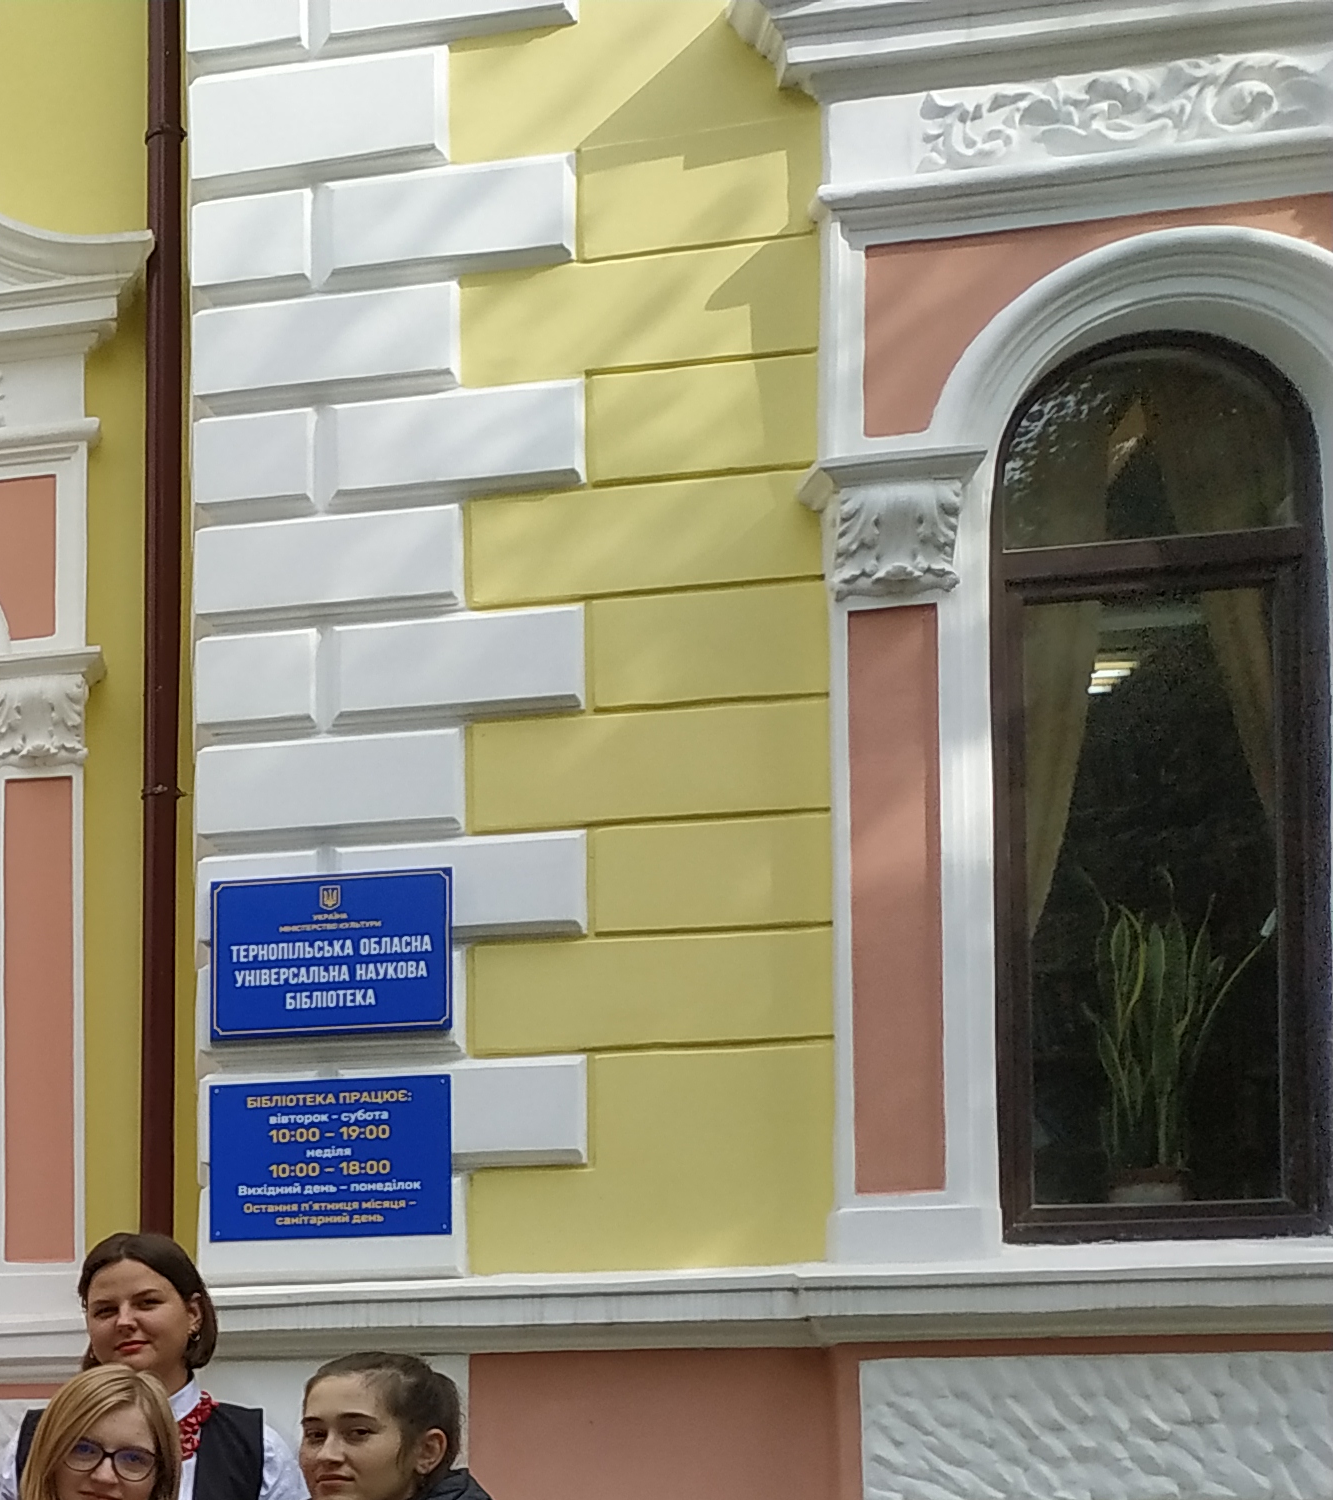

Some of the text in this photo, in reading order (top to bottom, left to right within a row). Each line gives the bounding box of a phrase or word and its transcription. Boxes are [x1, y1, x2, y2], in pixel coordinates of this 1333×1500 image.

[230, 934, 432, 963] ТЕРНОПІЛЬСЬКА ОБЛАСНА
[234, 961, 428, 988] УНІВЕРСАЛЬНА НАУКОВА
[285, 988, 376, 1010] БІБЛІОТЕКА
[246, 1089, 412, 1109] БІБЛІОТЕКА ПРАЦЮЄ:
[269, 1112, 329, 1125] вівторок
[340, 1109, 389, 1122] субота
[268, 1128, 321, 1143] 10:00
[339, 1124, 391, 1140] 19:00
[306, 1146, 352, 1159] неділя
[268, 1162, 321, 1178] 10:00
[338, 1159, 391, 1175] 18:00
[237, 1182, 302, 1197] Вихідний
[303, 1184, 338, 1195] день
[350, 1179, 422, 1193] понеділок
[243, 1202, 299, 1214] Остання
[361, 1198, 407, 1210] місяця
[275, 1213, 385, 1226] санітарний день
